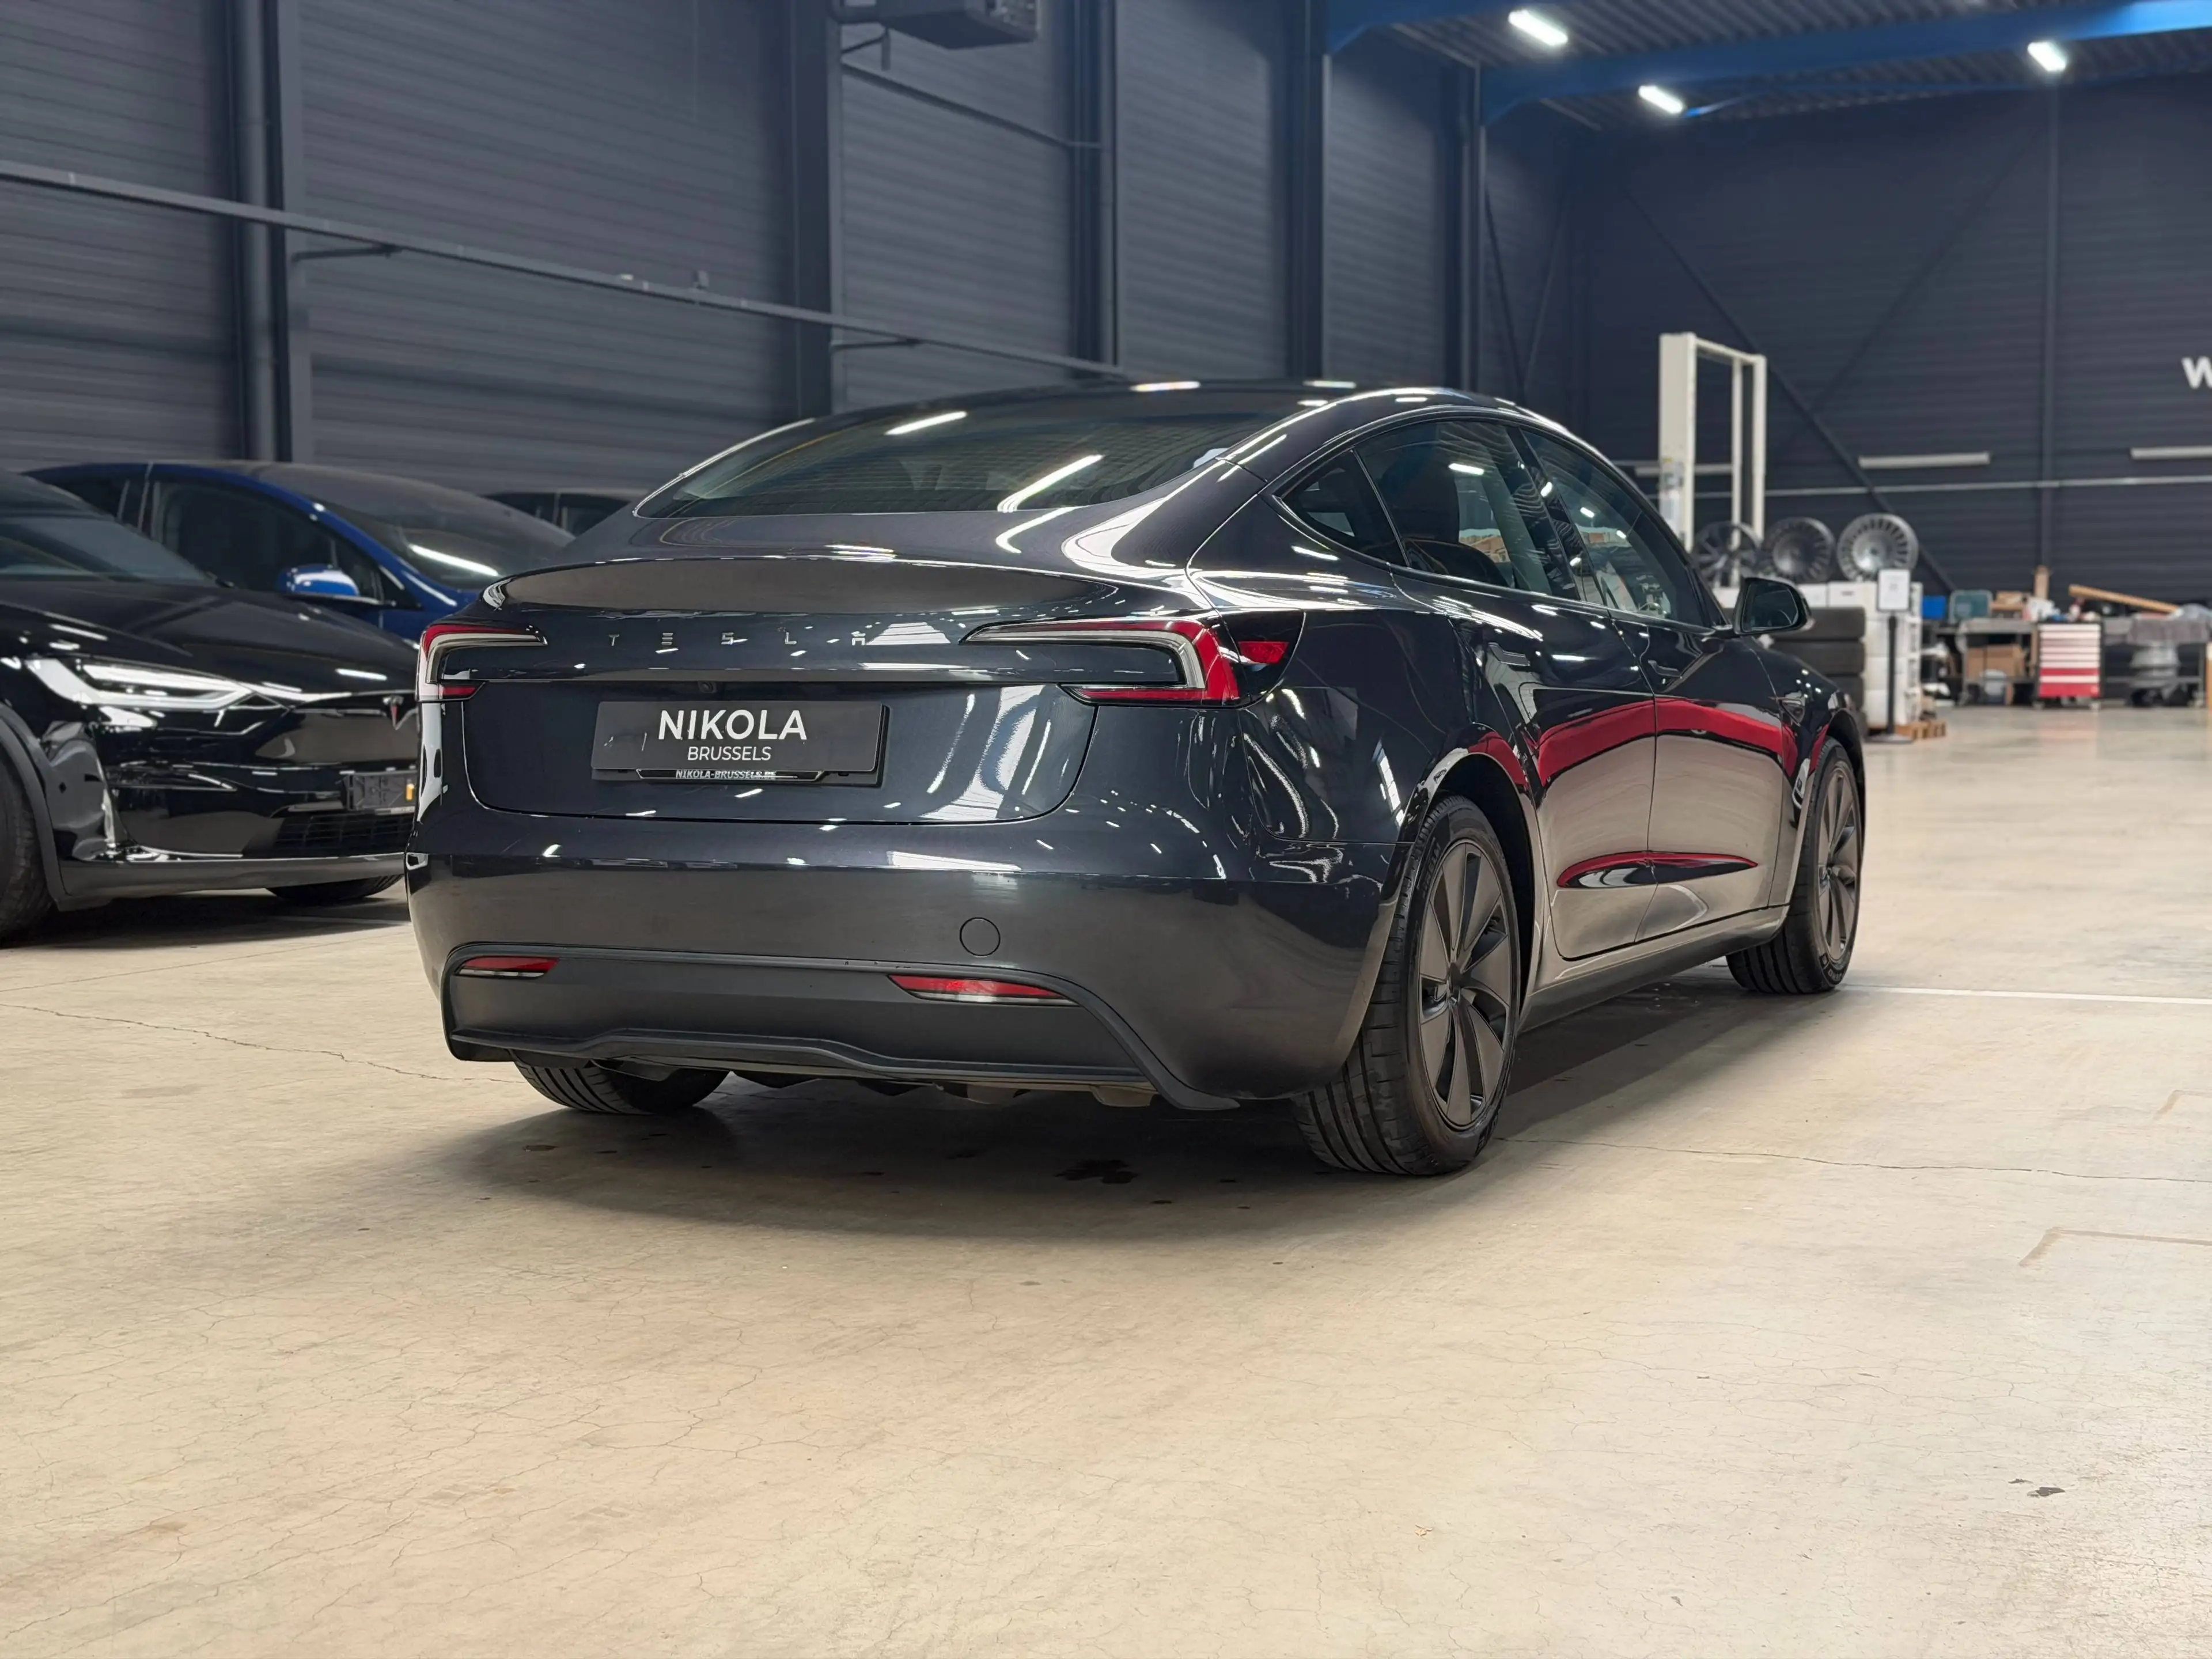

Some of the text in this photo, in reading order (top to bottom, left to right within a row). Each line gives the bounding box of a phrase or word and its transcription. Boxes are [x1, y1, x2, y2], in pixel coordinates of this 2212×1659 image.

[608, 631, 866, 646] TESLA
[658, 709, 808, 741] NIKOLA
[687, 746, 772, 761] BRUSSELS
